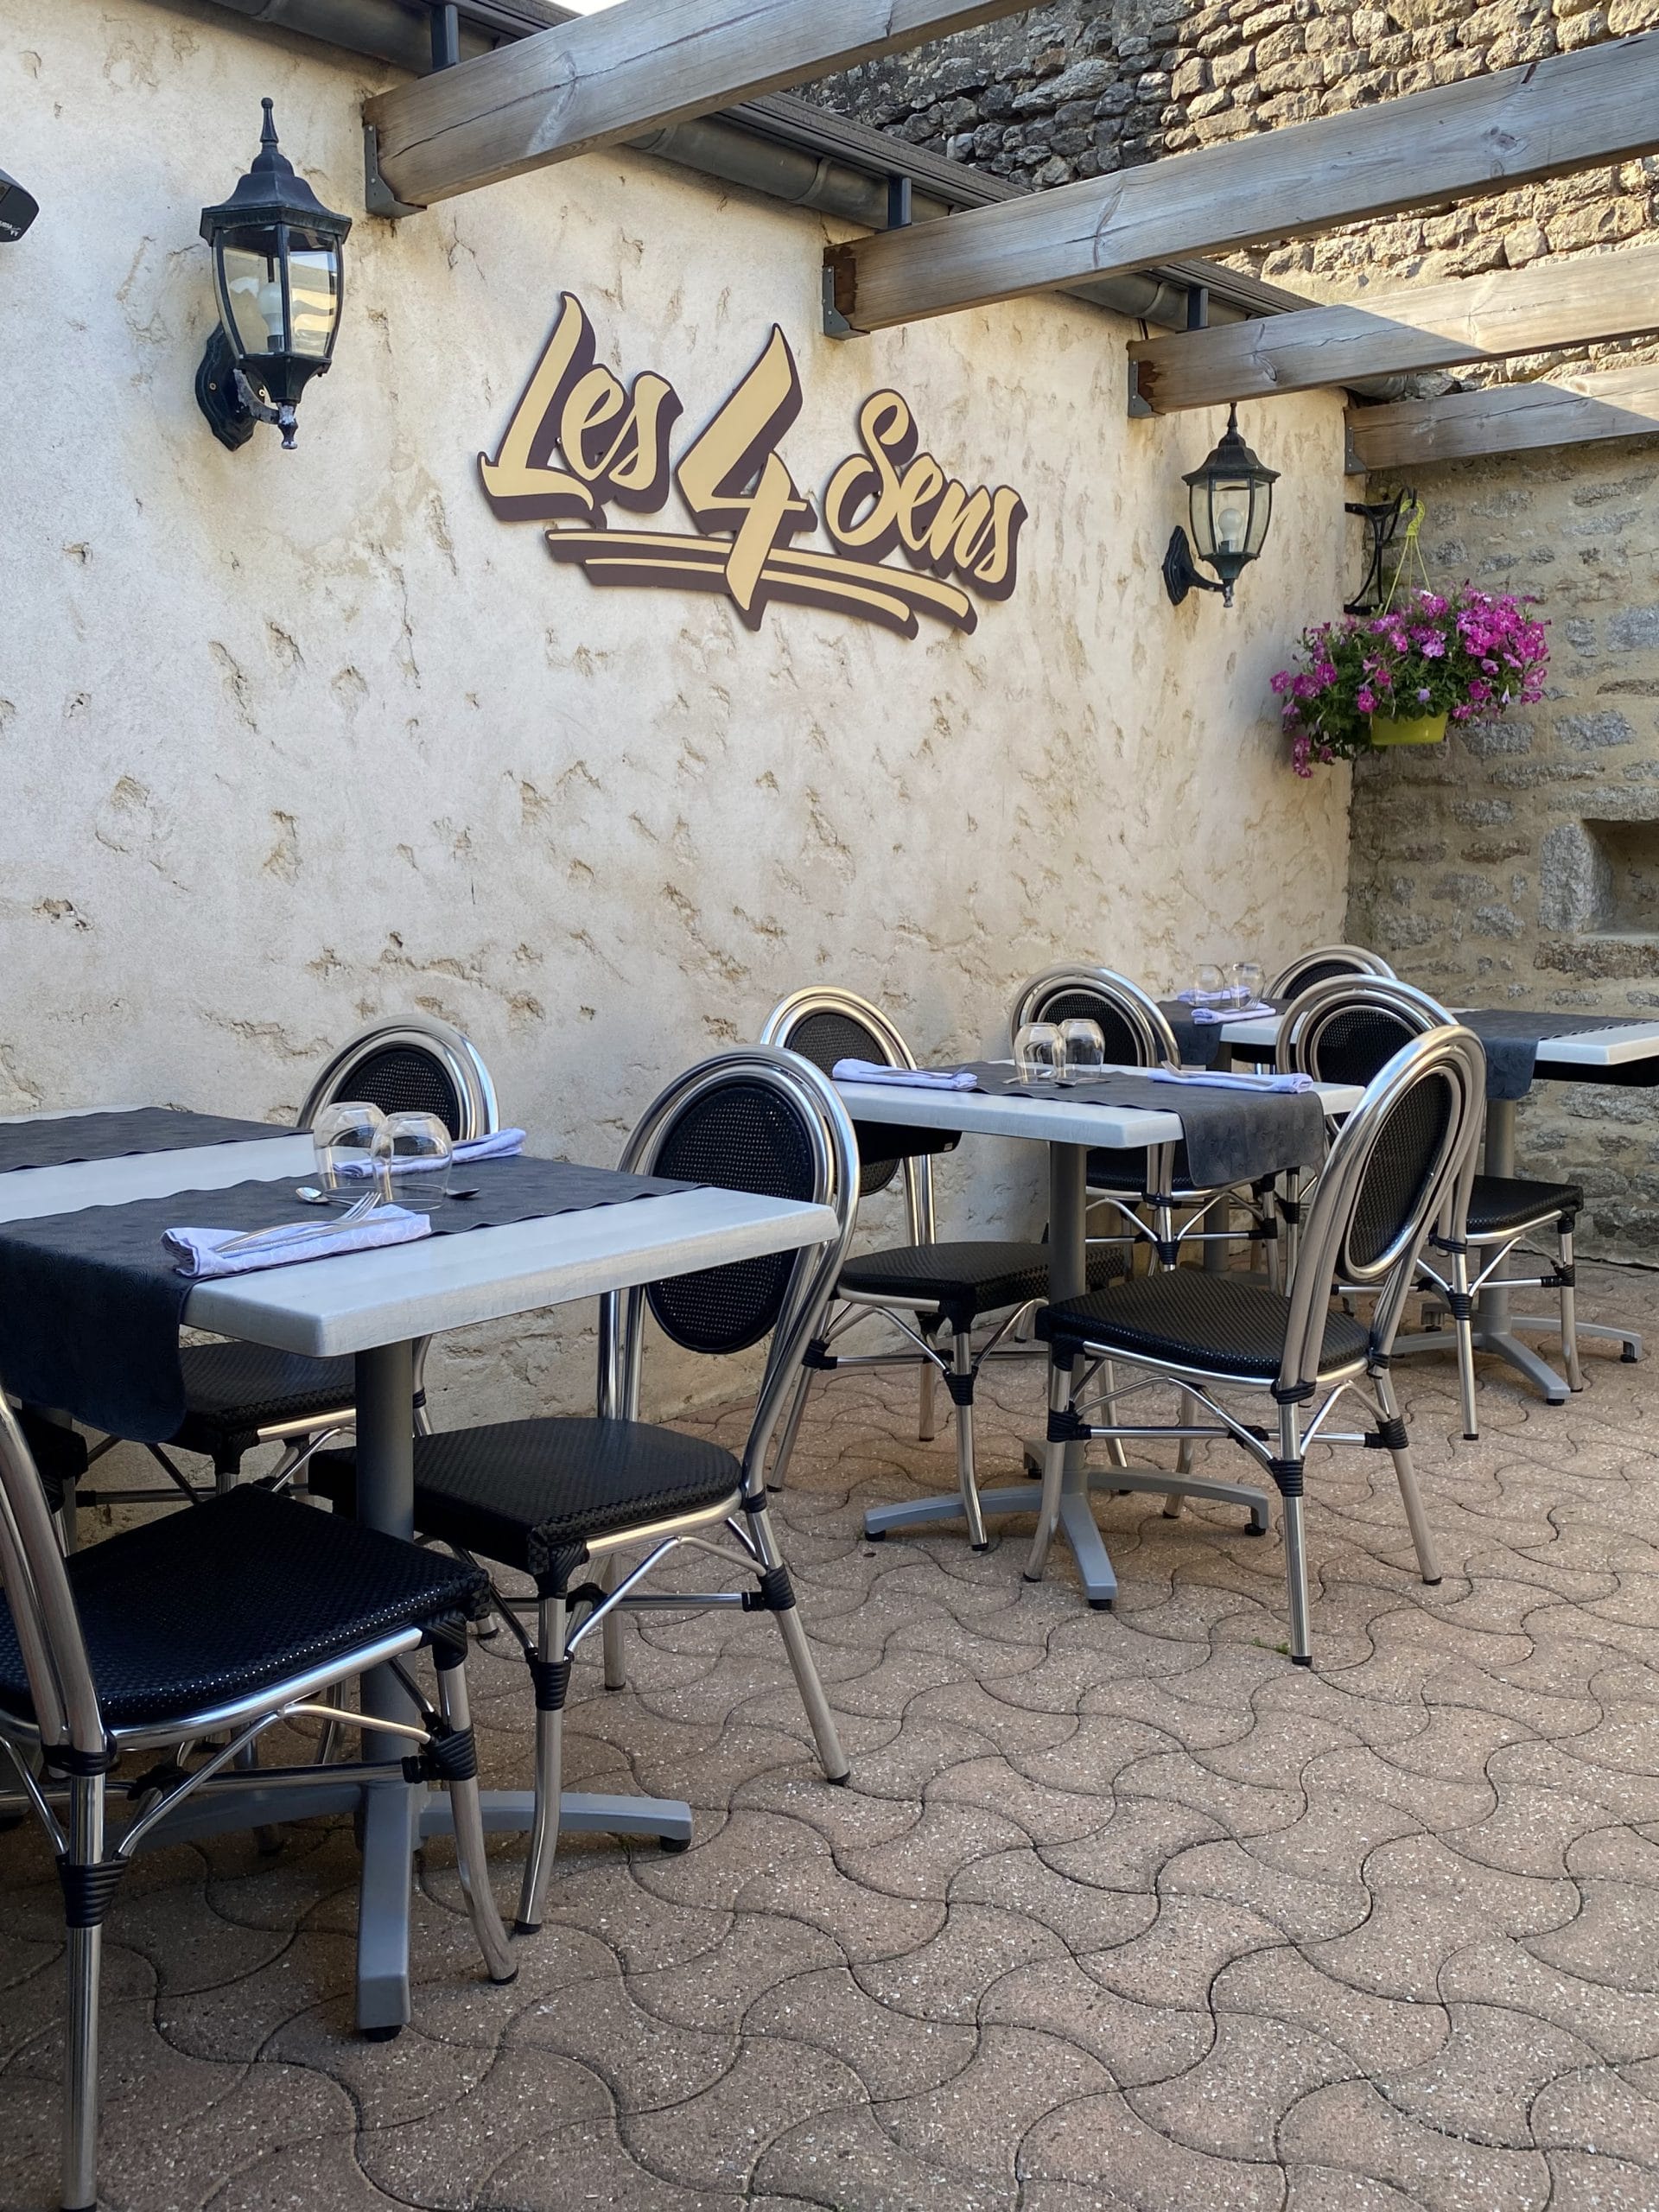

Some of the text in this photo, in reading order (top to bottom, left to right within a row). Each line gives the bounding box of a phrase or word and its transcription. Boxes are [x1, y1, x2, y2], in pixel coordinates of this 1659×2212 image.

[478, 292, 1025, 624] Les 4 Sens
